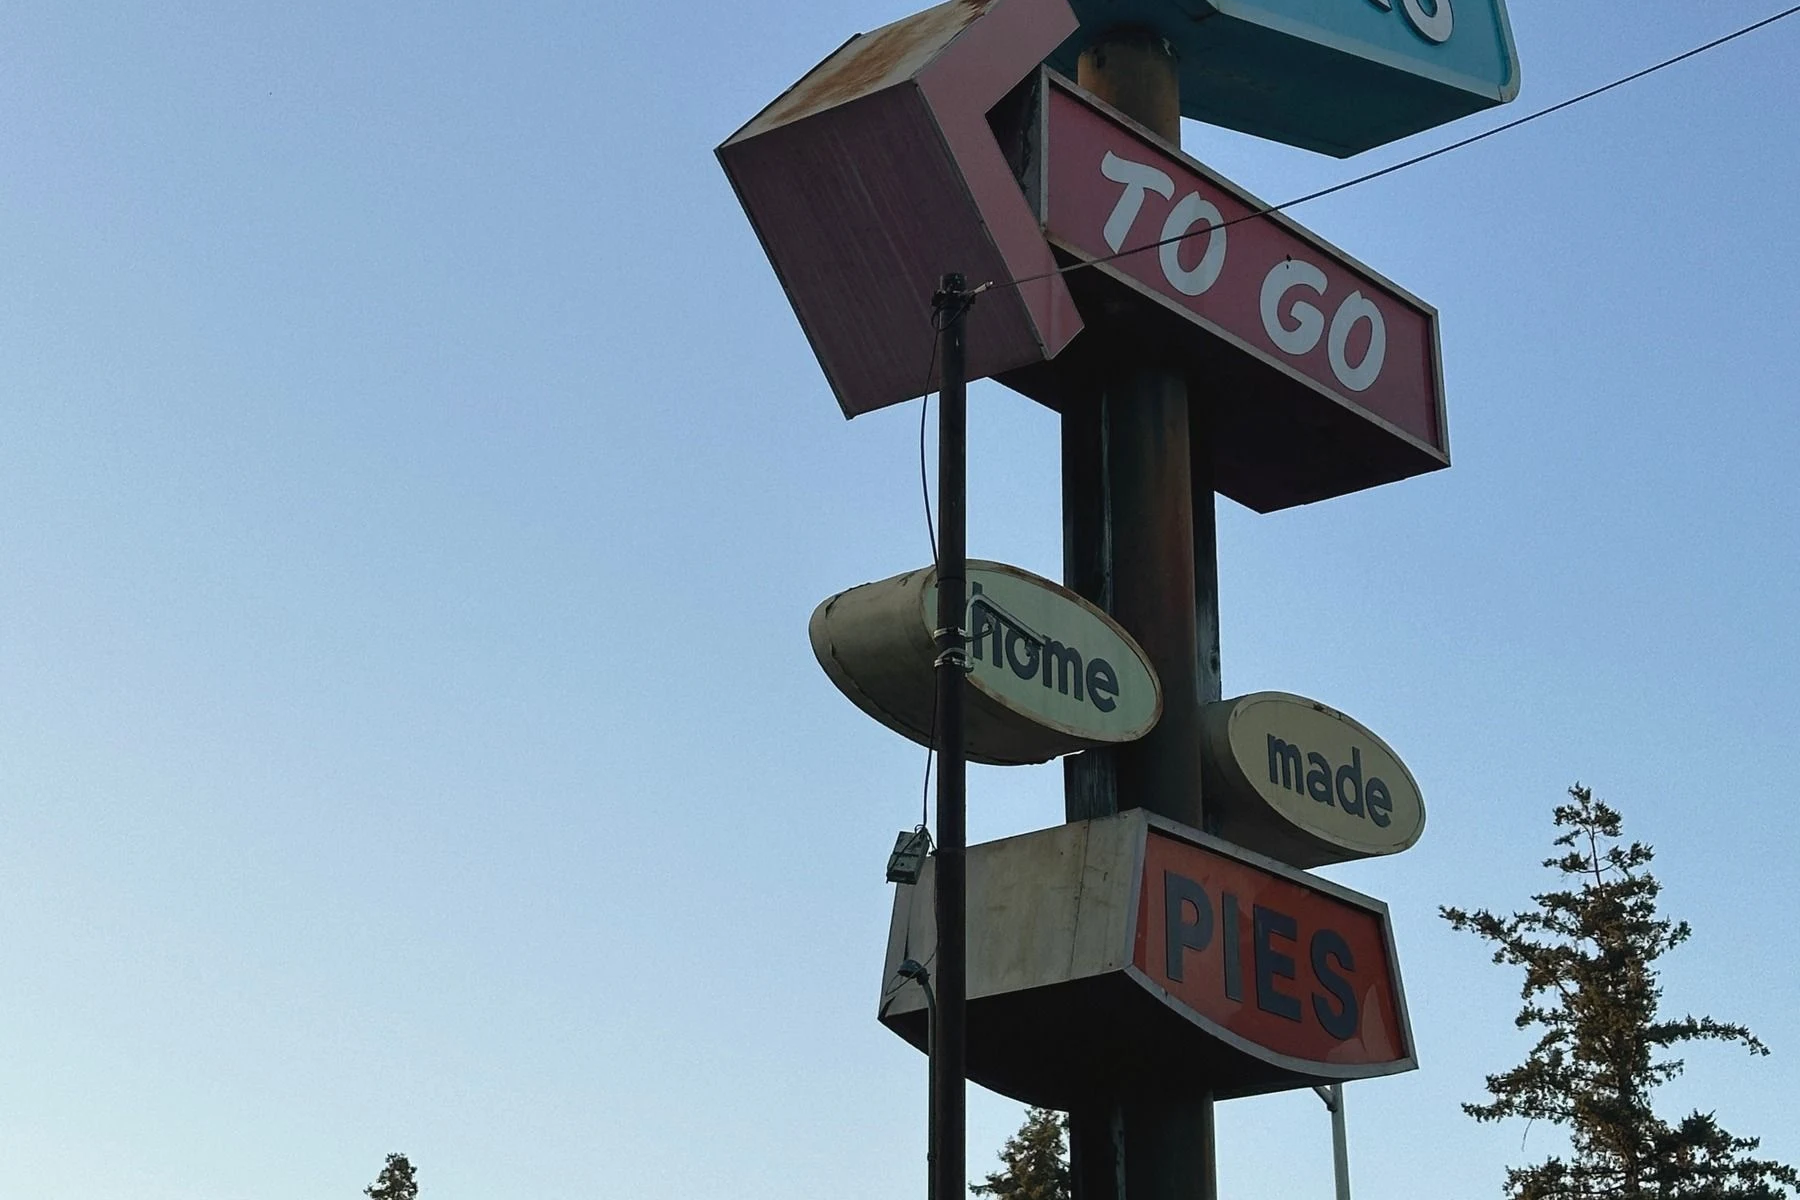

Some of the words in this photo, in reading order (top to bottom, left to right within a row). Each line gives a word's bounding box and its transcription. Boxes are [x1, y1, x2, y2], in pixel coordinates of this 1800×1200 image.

[1101, 150, 1227, 296] TO
[1259, 258, 1387, 392] GO
[971, 582, 1119, 712] home
[1266, 733, 1393, 828] made
[1164, 870, 1359, 1041] PIES
